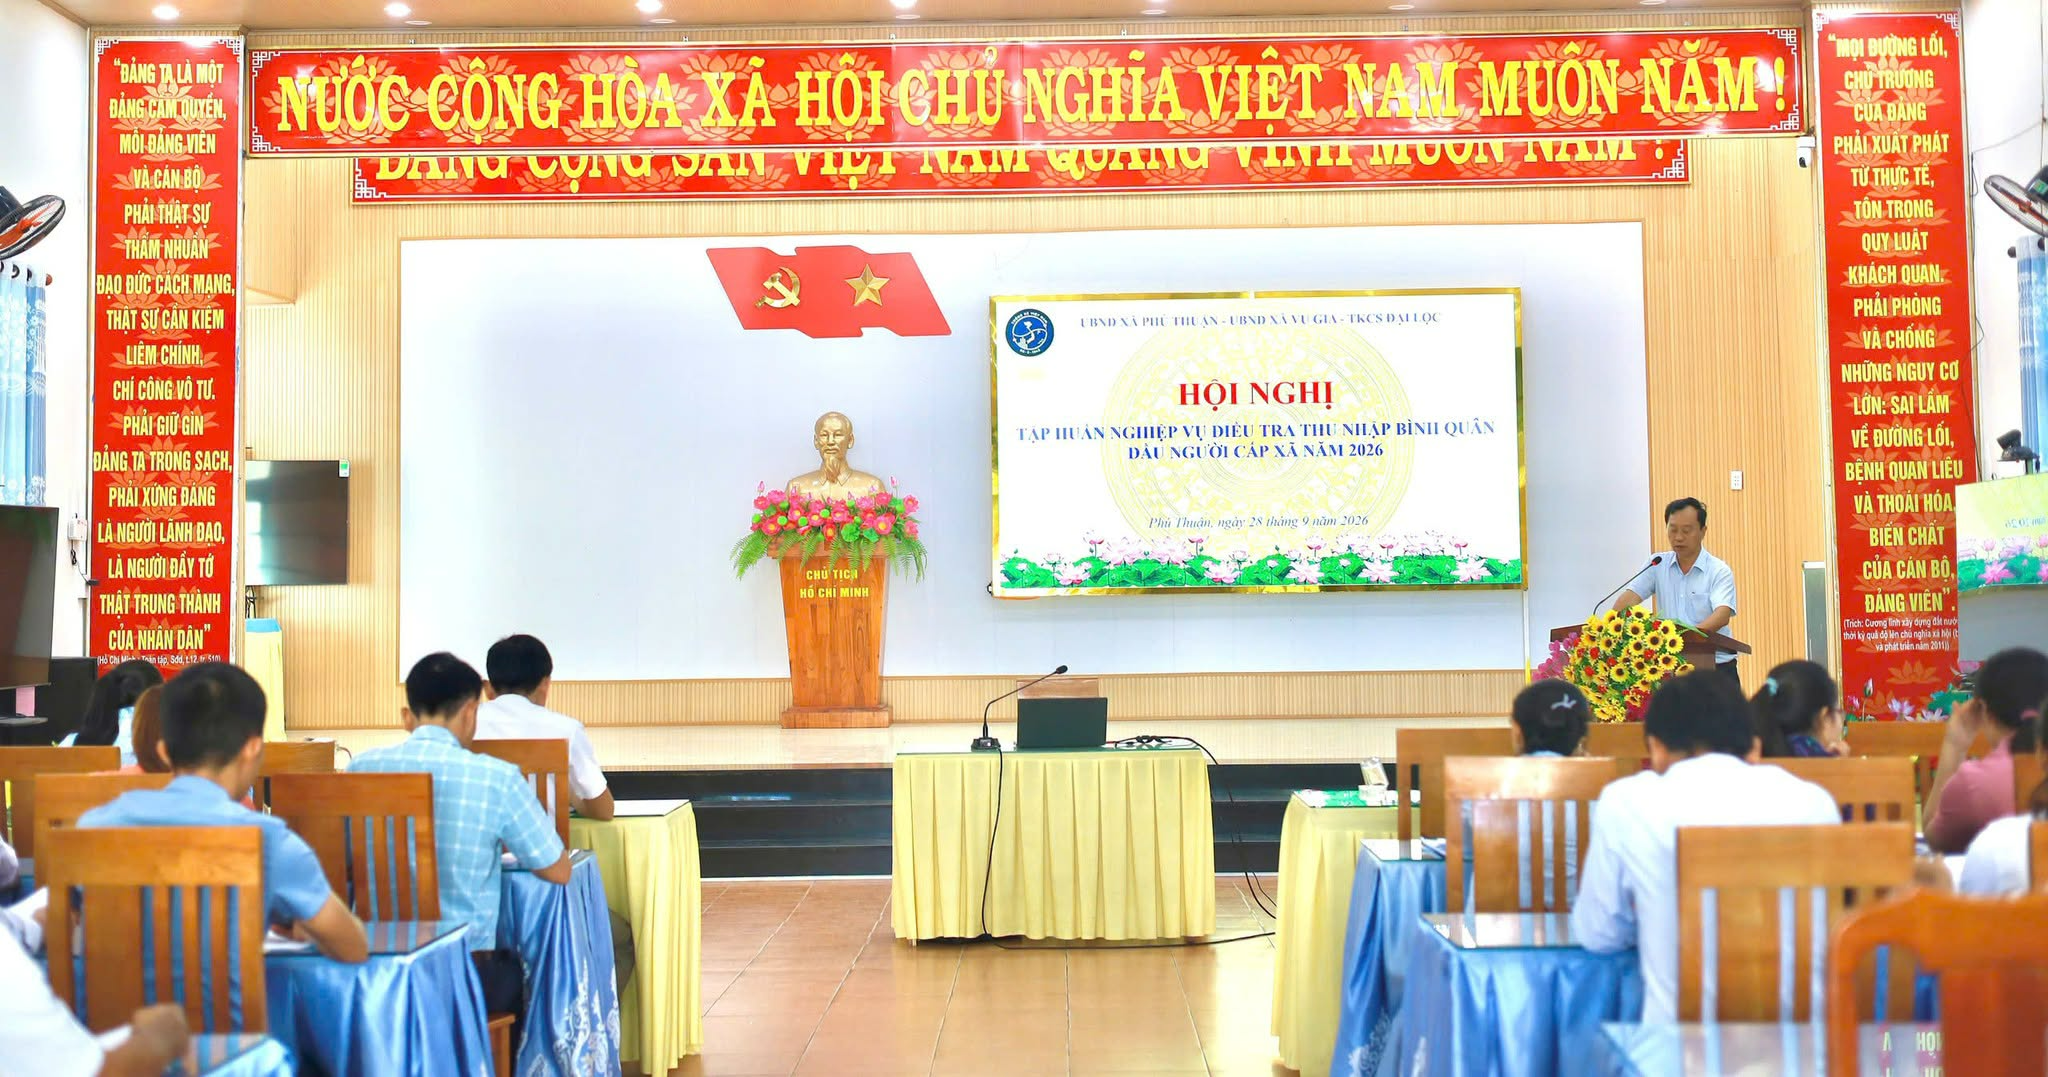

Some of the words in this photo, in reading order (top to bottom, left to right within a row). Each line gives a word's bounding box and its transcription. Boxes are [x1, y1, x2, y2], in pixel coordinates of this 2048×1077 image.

[159, 63, 172, 85] TA
[176, 60, 193, 84] LÀ
[196, 58, 224, 89] MỘT
[278, 54, 410, 132] NƯỚC
[428, 56, 562, 145] CỘNG
[579, 55, 681, 129] HÒA
[700, 56, 775, 127] XÃ
[795, 53, 885, 142] HỘI
[899, 46, 1005, 126] CHỦ
[1024, 50, 1186, 124] NGHĨA
[1197, 45, 1321, 135] VIỆT
[1343, 62, 1459, 119] NAM
[1479, 41, 1620, 115] MUÔN
[1641, 39, 1758, 113] NĂM
[119, 127, 145, 154] MỖI
[147, 127, 184, 154] ĐẢNG
[186, 129, 216, 154] VIÊN
[1833, 129, 1869, 155] PHẢI
[1872, 127, 1909, 154] XUẤT
[1912, 129, 1950, 153] PHÁT
[133, 164, 151, 189] VÀ
[153, 164, 180, 189] CÁN
[183, 163, 202, 194] BỘ
[1850, 161, 1870, 186] TỪ
[1872, 165, 1910, 191] THỰC
[124, 197, 155, 224] PHẢI
[158, 199, 191, 229] THẬT
[193, 201, 212, 229] SỰ
[1853, 195, 1883, 219] TÔN
[1886, 199, 1935, 223] TRỌNG
[124, 231, 160, 259] THẤM
[164, 231, 209, 259] NHUẦN
[1861, 232, 1890, 253] QUY
[1894, 226, 1929, 256] LUẬT
[96, 274, 123, 300] ĐẠO
[126, 268, 152, 295] ĐỨC
[155, 269, 189, 294] CÁCH
[1848, 260, 1898, 284] KHÁCH
[1853, 291, 1888, 317] PHẢI
[1891, 292, 1942, 316] PHÒNG
[106, 304, 139, 335] THẬT
[141, 307, 160, 335] SỰ
[162, 301, 189, 330] CẦN
[192, 304, 225, 334] KIỆM
[1080, 317, 1116, 327] UBND
[1230, 315, 1266, 326] UBND
[1348, 313, 1383, 323] TKCS
[1862, 325, 1883, 349] VÀ
[1885, 322, 1936, 348] CHỐNG
[126, 340, 158, 365] LIÊM
[1841, 357, 1893, 382] NHỮNG
[1896, 362, 1935, 381] NGUY
[1939, 359, 1960, 380] CƠ
[112, 375, 135, 401] CHÍ
[138, 375, 173, 400] CÔNG
[176, 375, 194, 400] VÔ
[1178, 379, 1238, 411] HỘI
[1250, 381, 1334, 410] NGHỊ
[1890, 395, 1915, 414] SAI
[1918, 386, 1951, 414] LẦM
[122, 408, 153, 436] PHẢI
[156, 409, 180, 436] GIỮ
[181, 410, 205, 435] GÌN
[1183, 425, 1206, 441] VỤ
[1259, 424, 1295, 437] TRA
[1300, 423, 1337, 436] THU
[1397, 419, 1439, 435] BÌNH
[1851, 421, 1871, 448] VỀ
[1873, 422, 1924, 447] ĐƯỜNG
[93, 444, 129, 471] ĐẢNG
[131, 451, 146, 471] TA
[149, 451, 192, 471] TRONG
[1274, 442, 1298, 457] XÃ
[1303, 442, 1343, 457] NĂM
[1349, 444, 1383, 457] 2026
[1845, 457, 1886, 486] BỆNH
[1888, 461, 1929, 481] QUAN
[1932, 455, 1964, 479] LIÊU
[108, 480, 140, 507] PHẢI
[142, 480, 177, 507] XỨNG
[180, 481, 216, 506] ĐÁNG
[1854, 490, 1875, 514] VÀ
[1877, 489, 1921, 513] THOÁI
[97, 517, 116, 543] LÀ
[117, 516, 157, 543] NGƯỜI
[159, 517, 194, 542] LÃNH
[1249, 517, 1263, 527] 28
[1302, 516, 1309, 526] 9
[1340, 515, 1369, 526] 2026
[1869, 519, 1905, 546] BIẾN
[1907, 518, 1945, 545] CHẤT
[108, 554, 125, 579] LÀ
[127, 552, 167, 578] NGƯỜI
[169, 549, 196, 578] ĐẦY
[198, 551, 215, 577] TỚ
[1862, 553, 1893, 579] CỦA
[1896, 555, 1928, 579] CÁN
[99, 589, 132, 619] THẬT
[134, 594, 176, 614] TRUNG
[179, 588, 221, 613] THÀNH
[840, 587, 869, 598] MINH
[1864, 587, 1906, 613] ĐẢNG
[108, 623, 135, 650] CỦA
[137, 625, 175, 650] NHÂN
